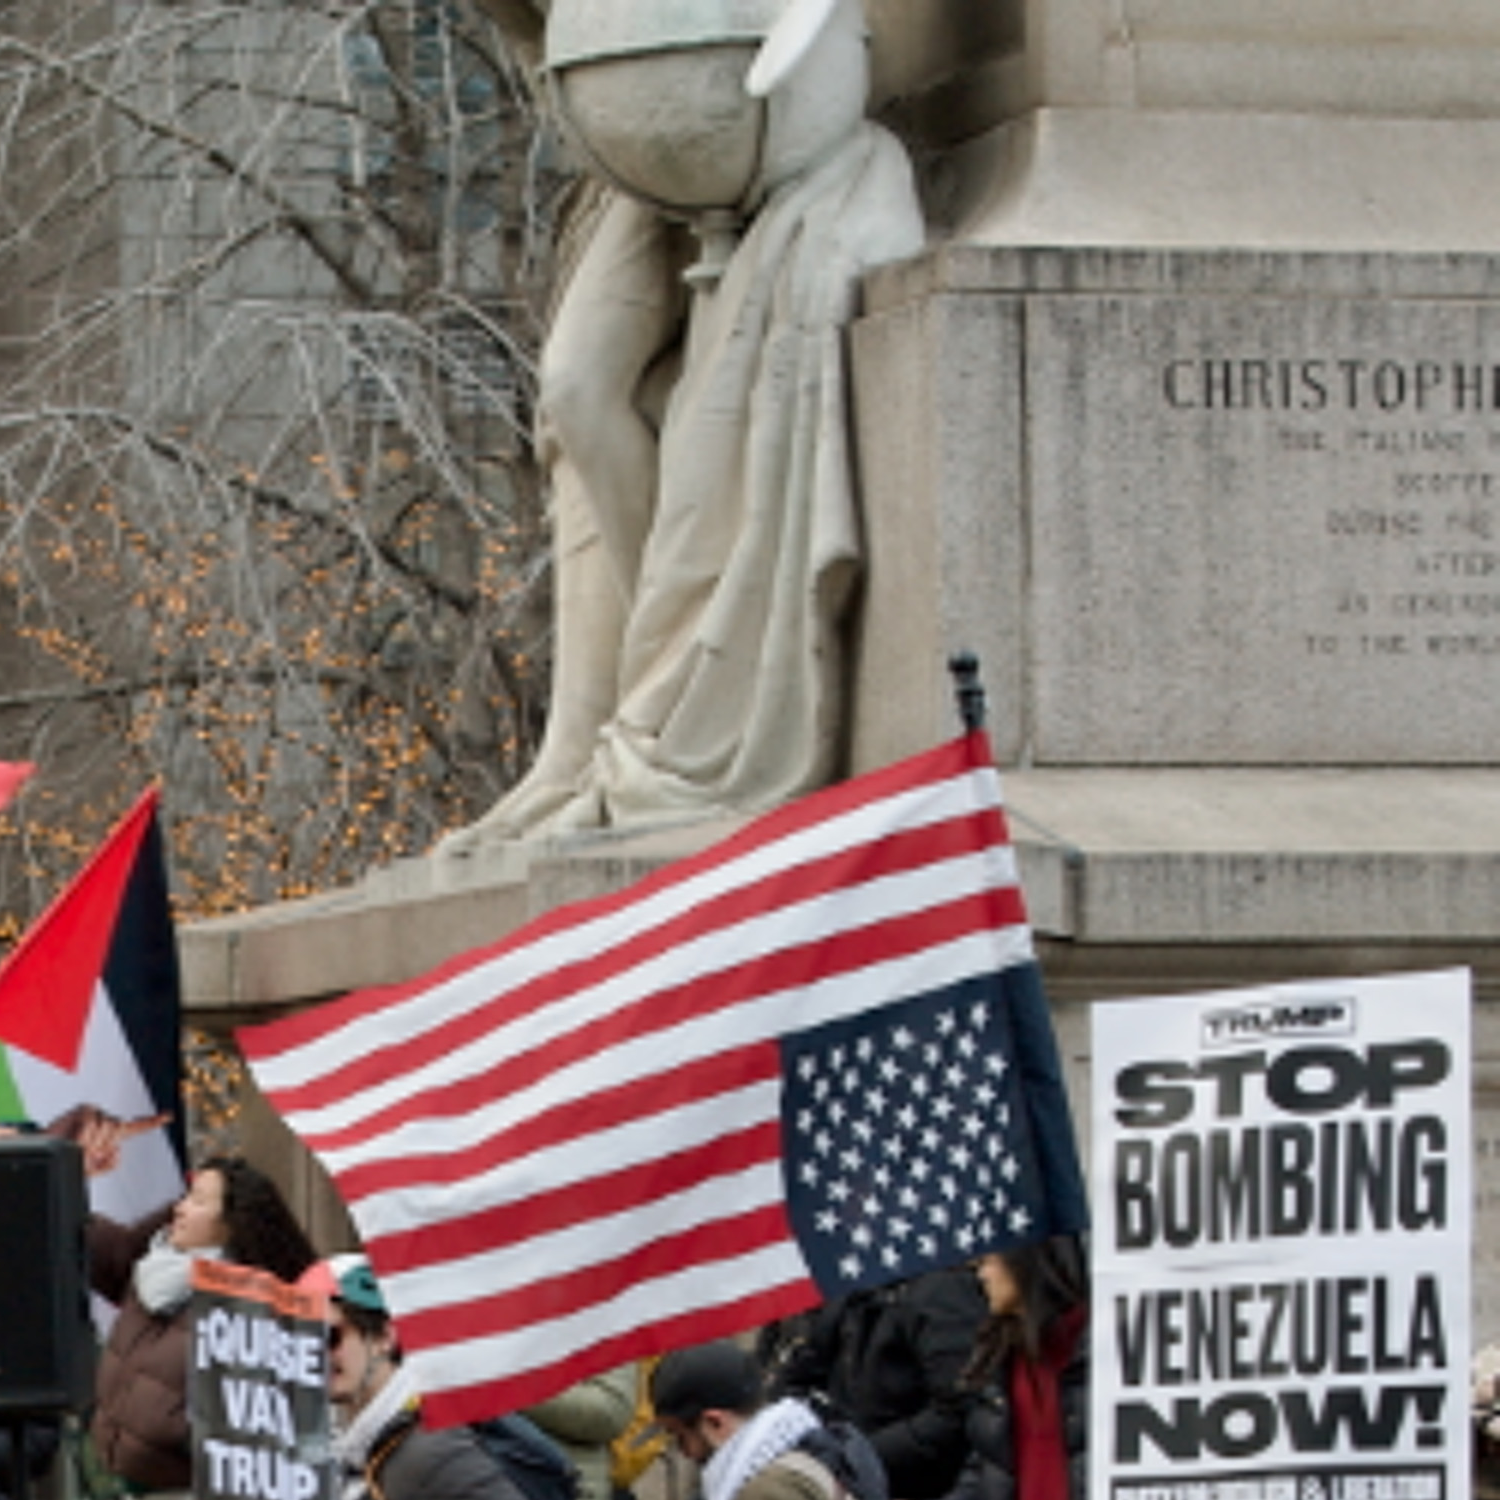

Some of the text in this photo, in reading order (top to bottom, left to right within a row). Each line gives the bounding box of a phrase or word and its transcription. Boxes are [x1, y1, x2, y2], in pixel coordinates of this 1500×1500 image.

[1206, 1005, 1346, 1038] TRUMP
[1113, 1038, 1451, 1128] STOP
[1115, 1115, 1447, 1252] BOMBING
[1115, 1274, 1447, 1387] VENEZUELA
[1113, 1384, 1447, 1464] NOW!
